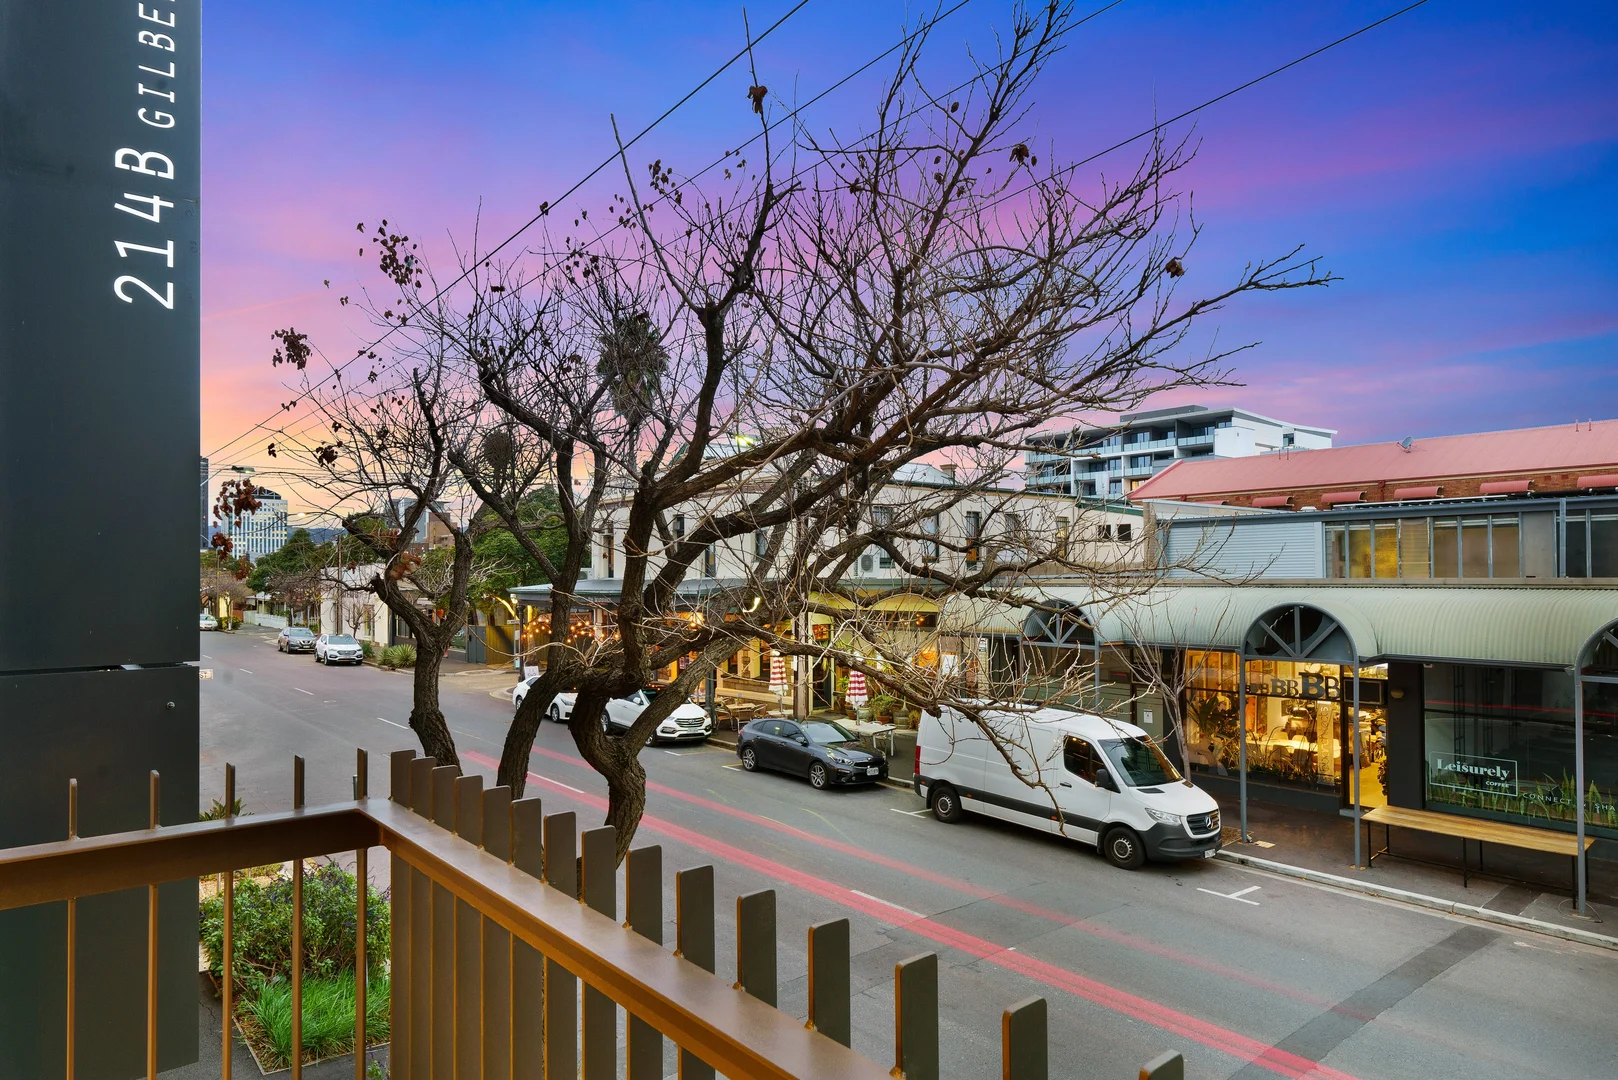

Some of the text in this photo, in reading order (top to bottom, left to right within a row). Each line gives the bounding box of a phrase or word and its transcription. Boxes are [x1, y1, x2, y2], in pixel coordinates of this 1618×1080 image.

[113, 0, 175, 310] 214B GILBE
[1436, 758, 1510, 780] Leisurely
[1485, 780, 1509, 788] COFFEE
[1522, 792, 1572, 805] CONNECT
